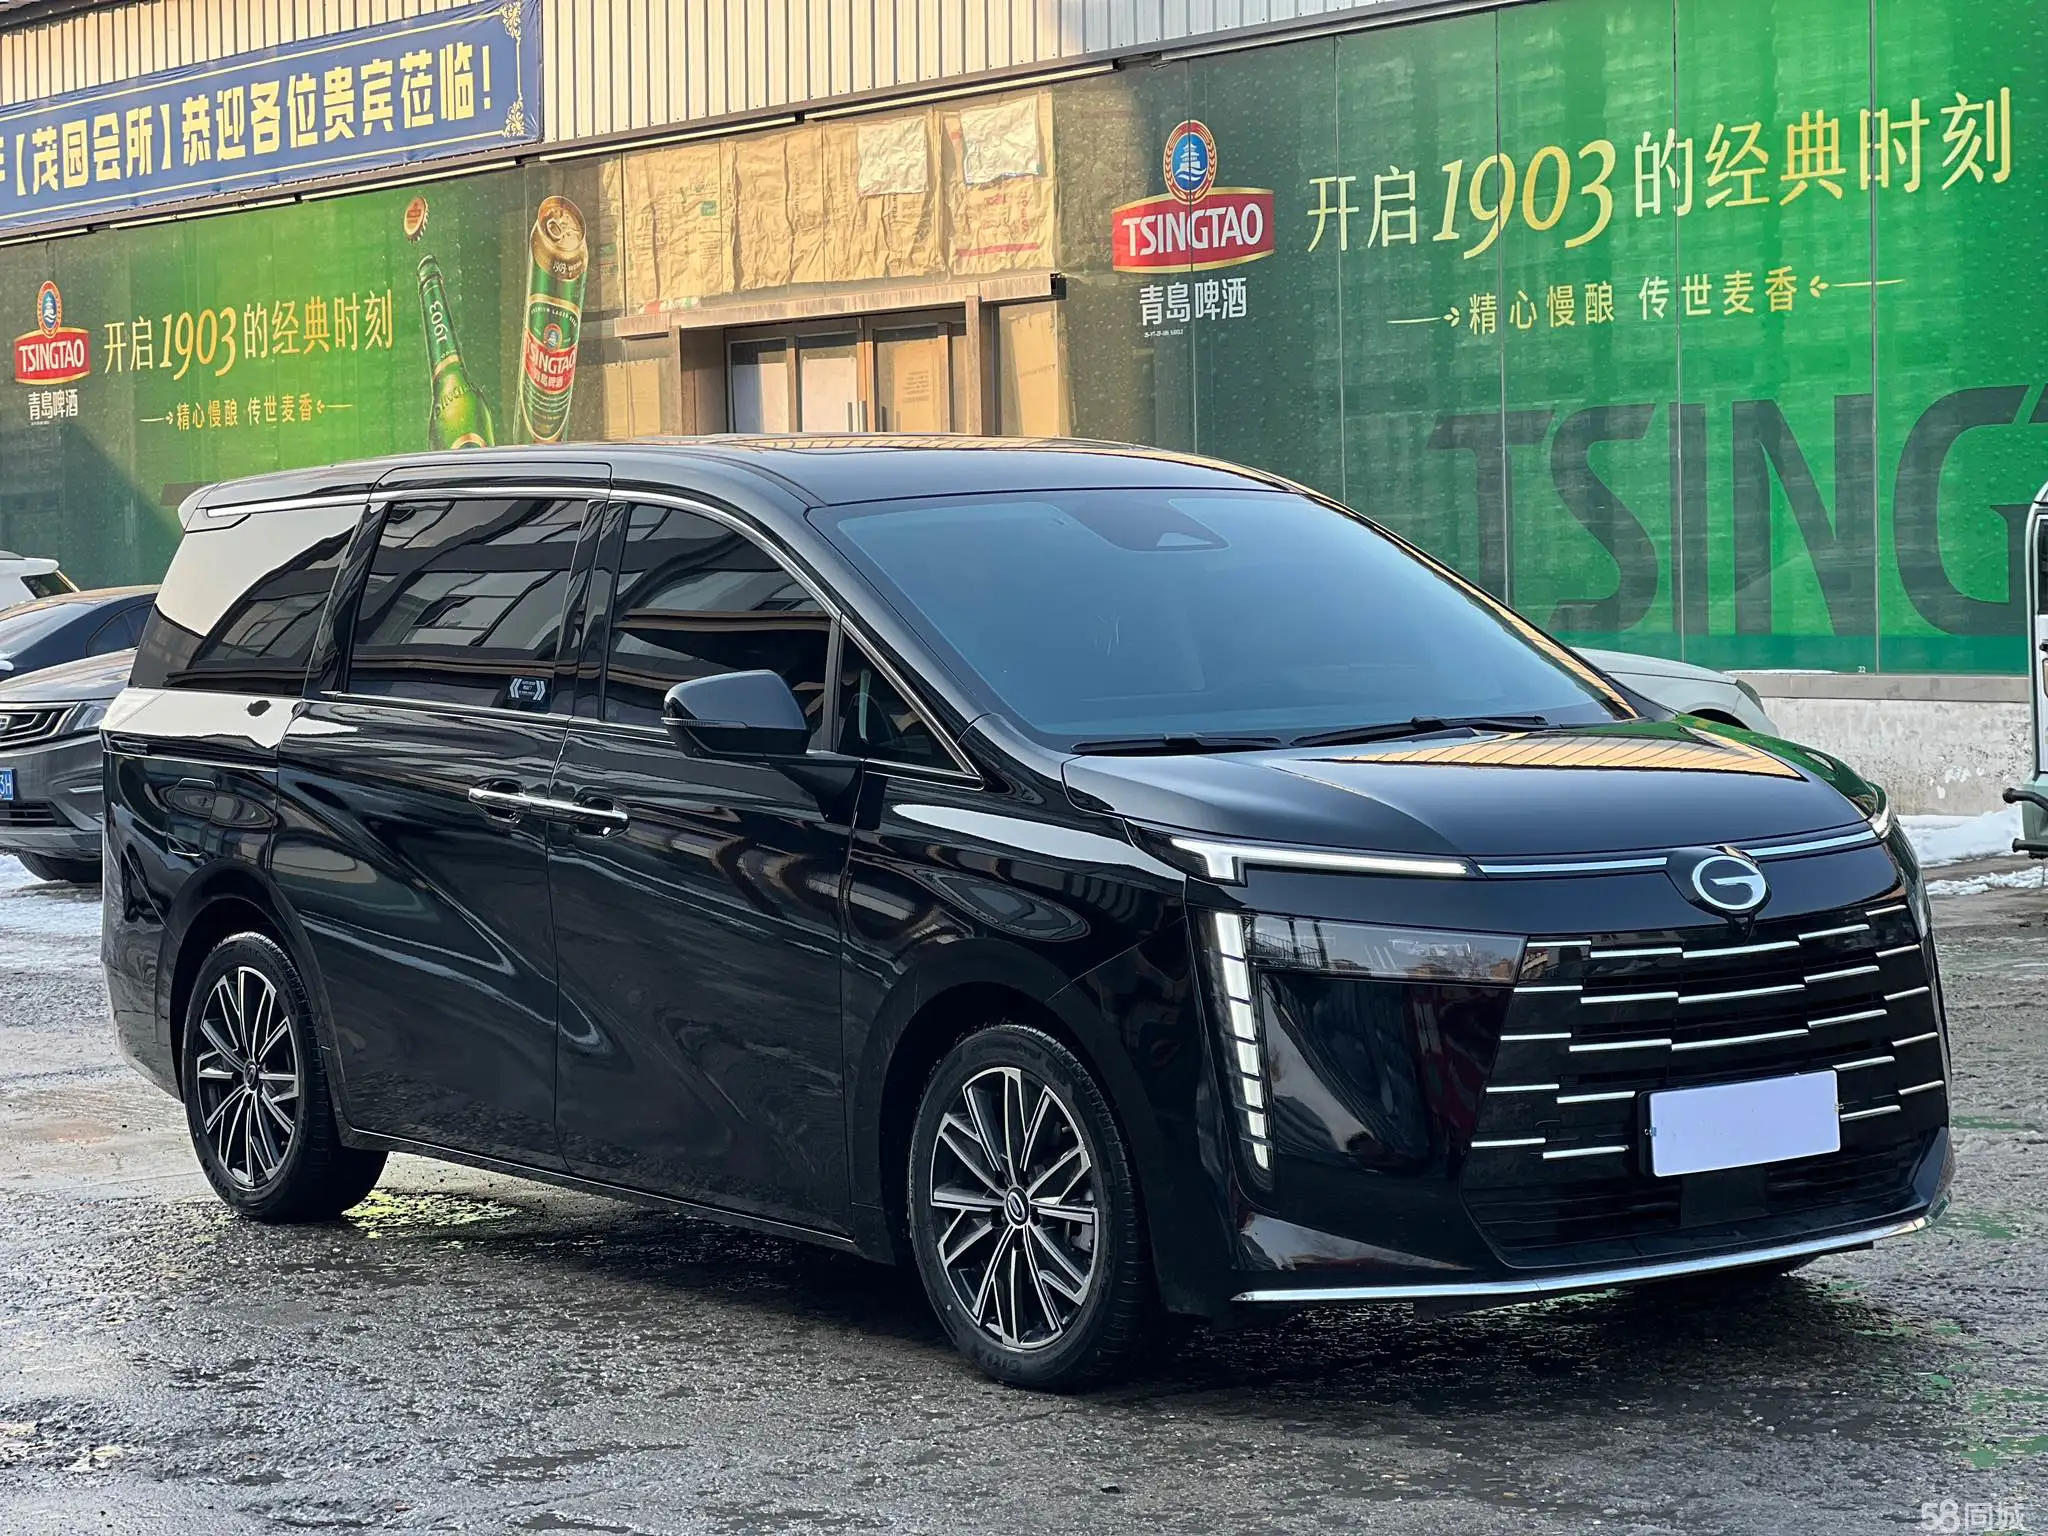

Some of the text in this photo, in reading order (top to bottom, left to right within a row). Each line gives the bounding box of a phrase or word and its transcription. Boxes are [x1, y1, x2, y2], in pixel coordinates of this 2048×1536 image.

[1306, 87, 2012, 260] 开启1903的经典时刻
[1121, 203, 1264, 257] TSINGTAO
[429, 299, 448, 344] 1903
[1139, 277, 1247, 326] 青島啤酒
[1468, 265, 1798, 336] 精心慢酿 传世麦香
[18, 338, 85, 373] TSINGTAO
[103, 289, 393, 381] 开启1903的经典时刻
[28, 388, 79, 421] 青島啤酒
[176, 393, 313, 431] 精心慢酿 传世麦香
[1427, 384, 2048, 636] TSING
